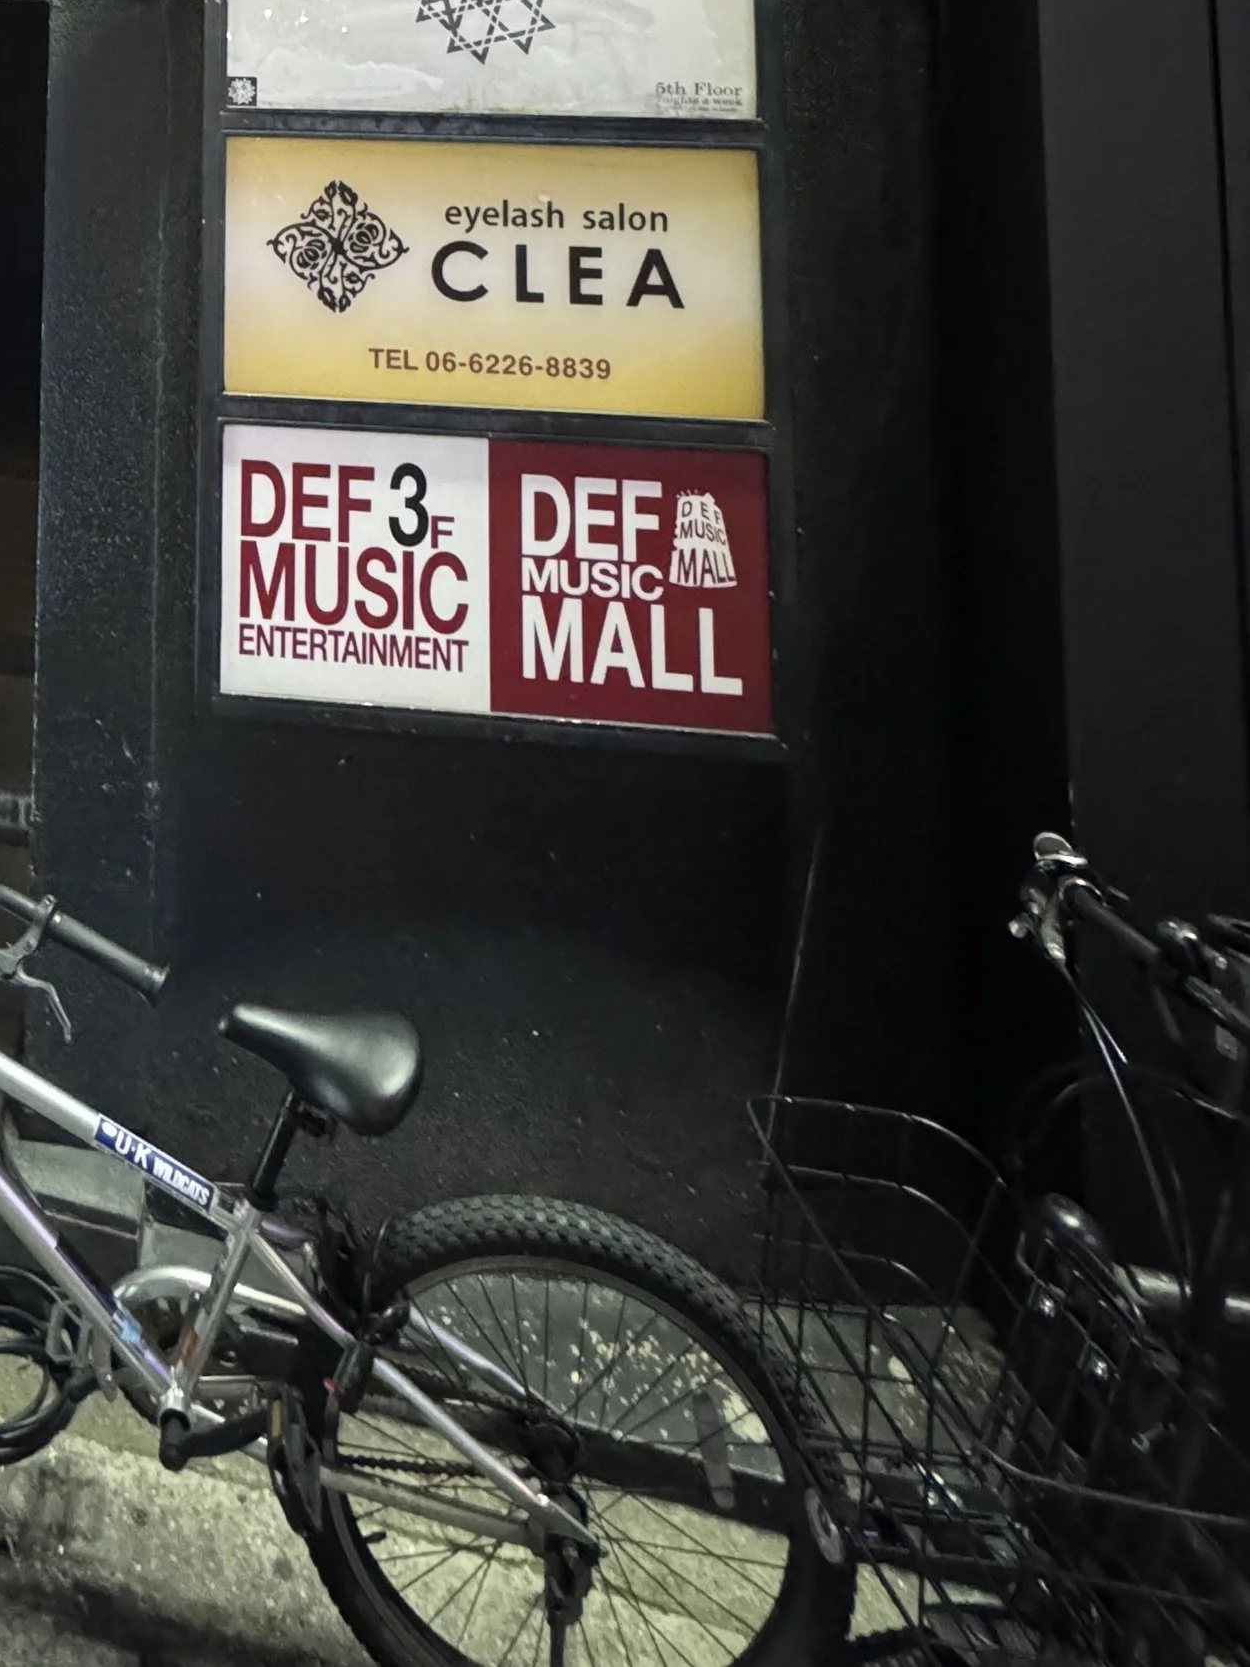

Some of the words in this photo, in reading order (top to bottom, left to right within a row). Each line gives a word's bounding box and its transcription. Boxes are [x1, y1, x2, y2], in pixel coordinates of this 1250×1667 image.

[655, 81, 686, 95] 5th
[694, 81, 742, 96] Floor
[444, 199, 565, 233] eyelash
[582, 202, 669, 232] salon
[431, 240, 685, 309] CLEA
[368, 347, 419, 371] TEL
[425, 350, 612, 380] 06-6226-8839
[240, 459, 375, 543] DEF
[521, 473, 663, 562] DEF
[681, 500, 720, 525] DEF
[679, 518, 727, 546] MUSIC
[239, 539, 469, 635] MUSIC
[521, 557, 665, 601] MUSIC
[677, 548, 736, 586] MALL
[239, 623, 470, 673] ENTERTAINMENT
[521, 594, 743, 695] MALL
